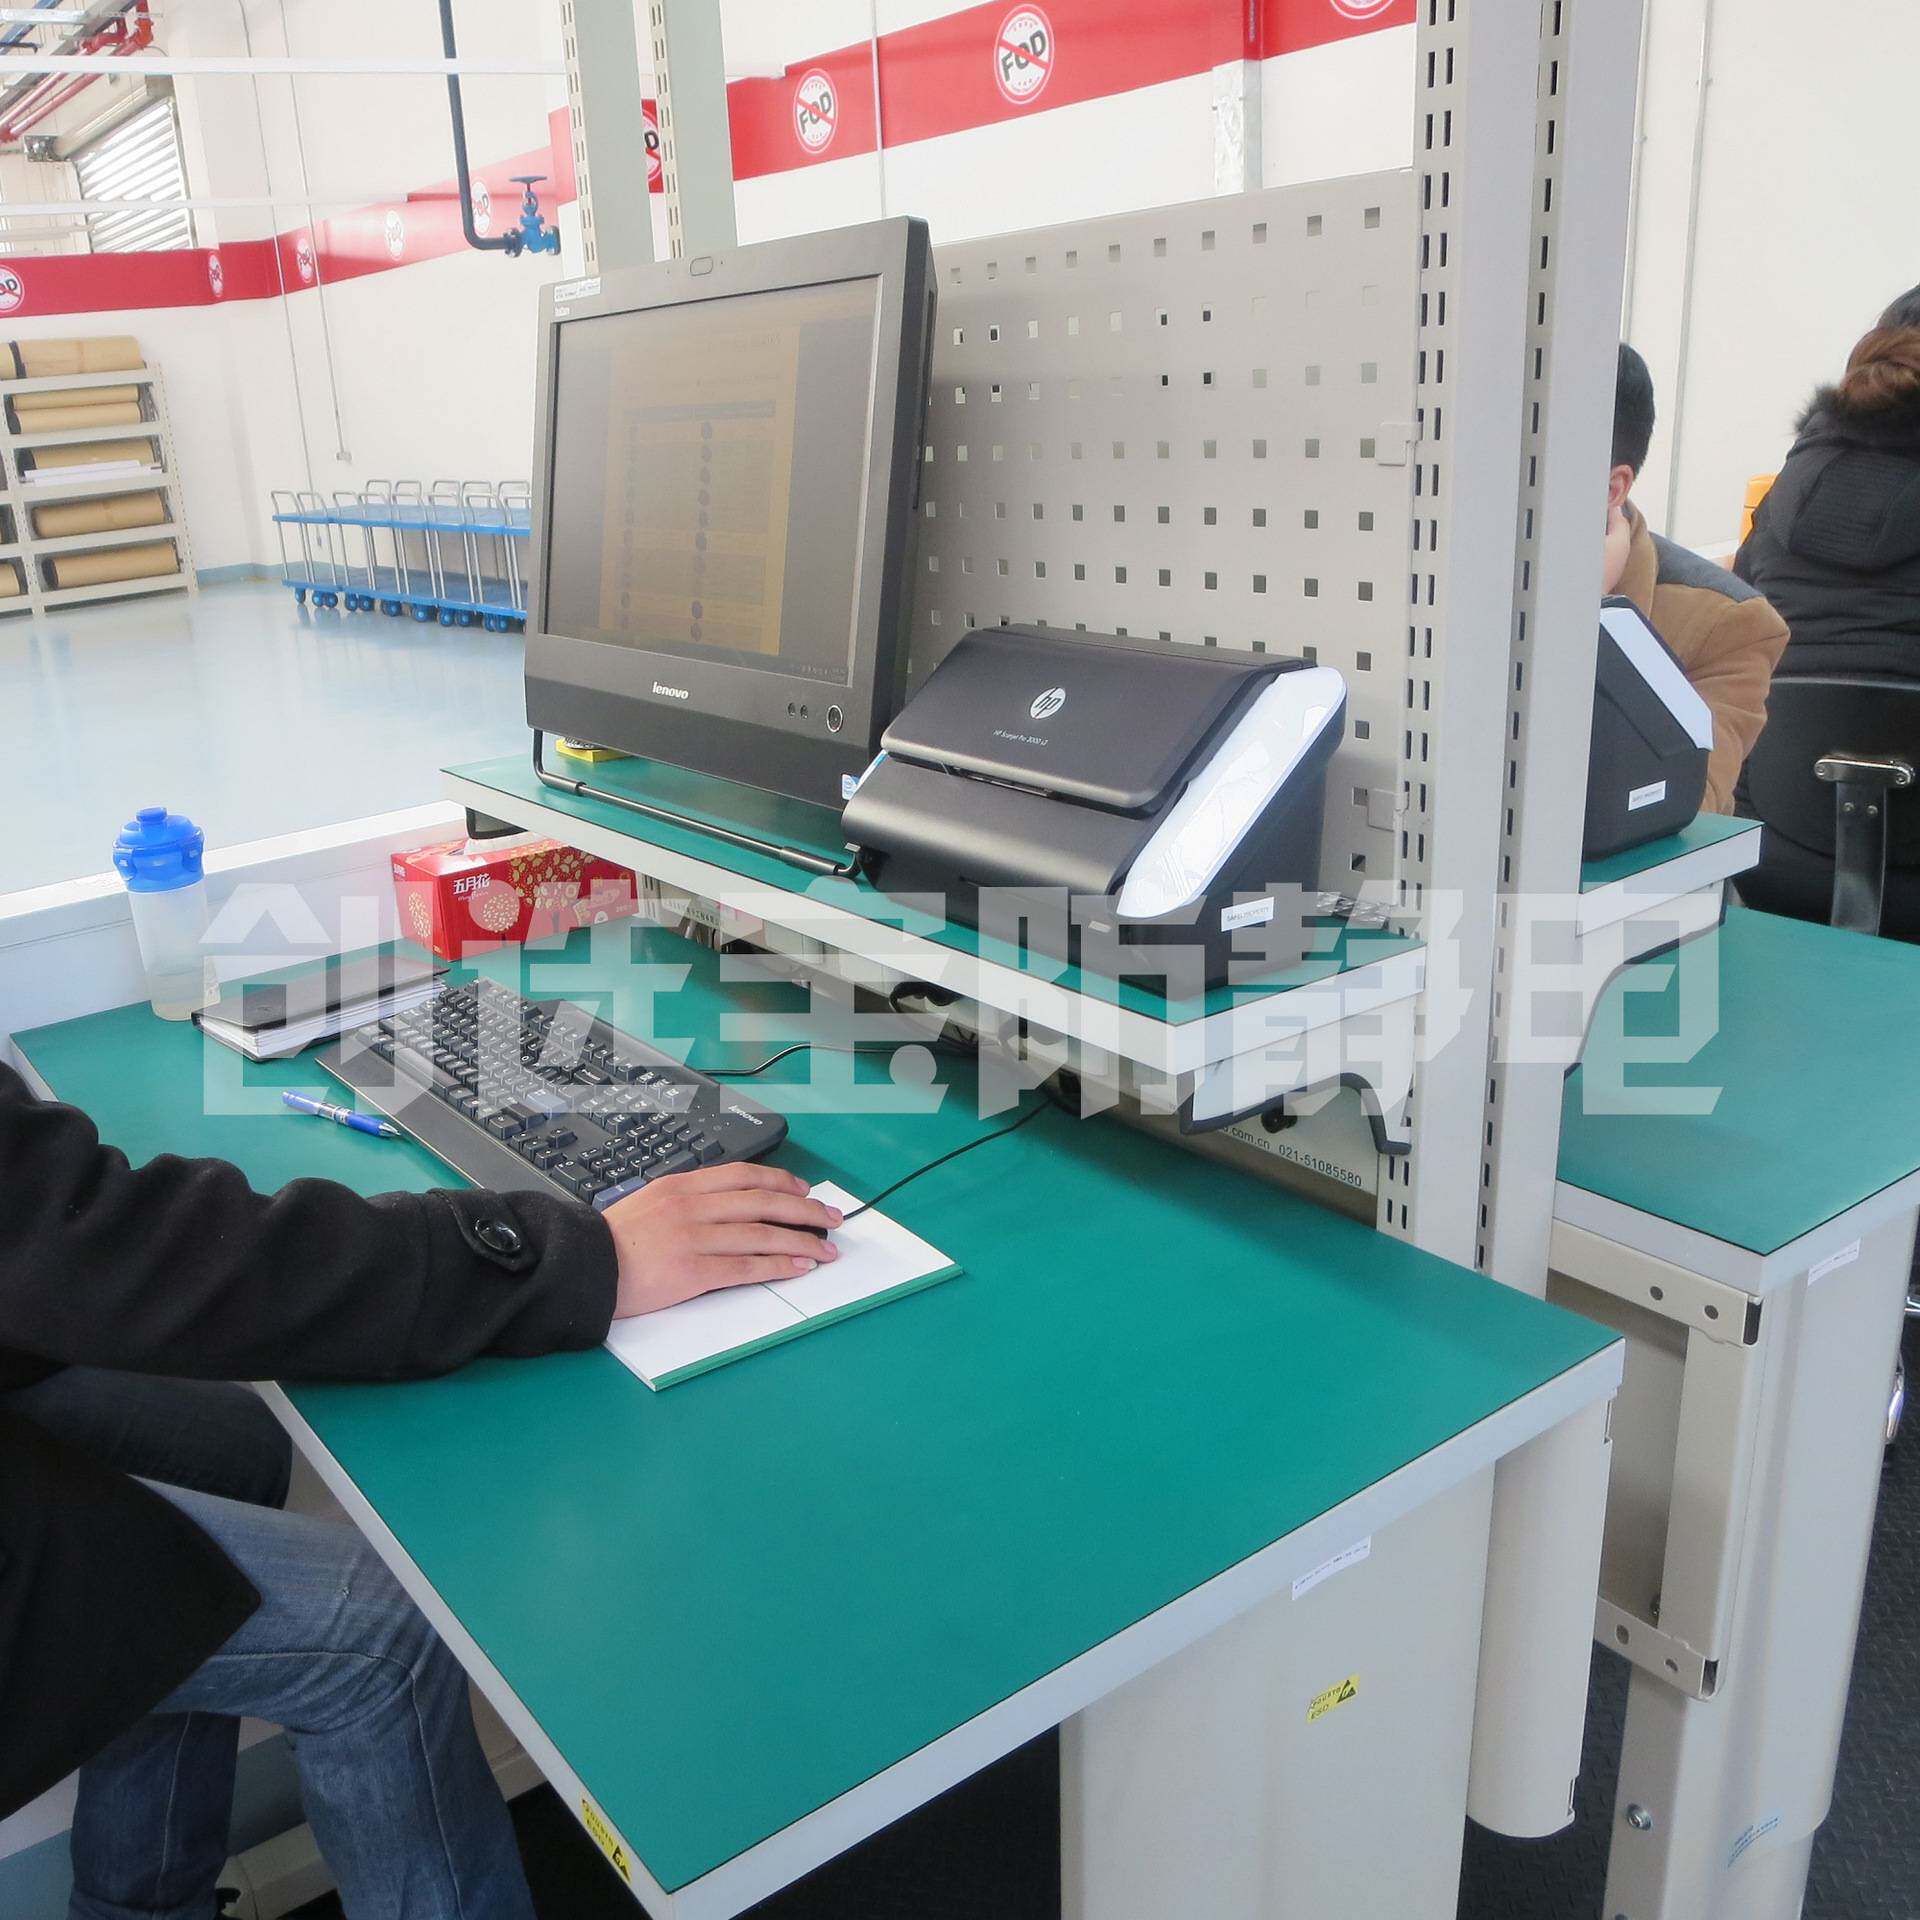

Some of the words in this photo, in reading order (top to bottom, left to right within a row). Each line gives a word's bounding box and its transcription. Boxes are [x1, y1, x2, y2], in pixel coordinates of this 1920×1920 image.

[1001, 30, 1046, 82] FOD
[799, 91, 832, 135] FOD
[652, 681, 689, 700] lenovo
[1033, 688, 1064, 718] hp
[453, 873, 491, 895] 五月花
[1278, 1143, 1363, 1188] 021-51085580
